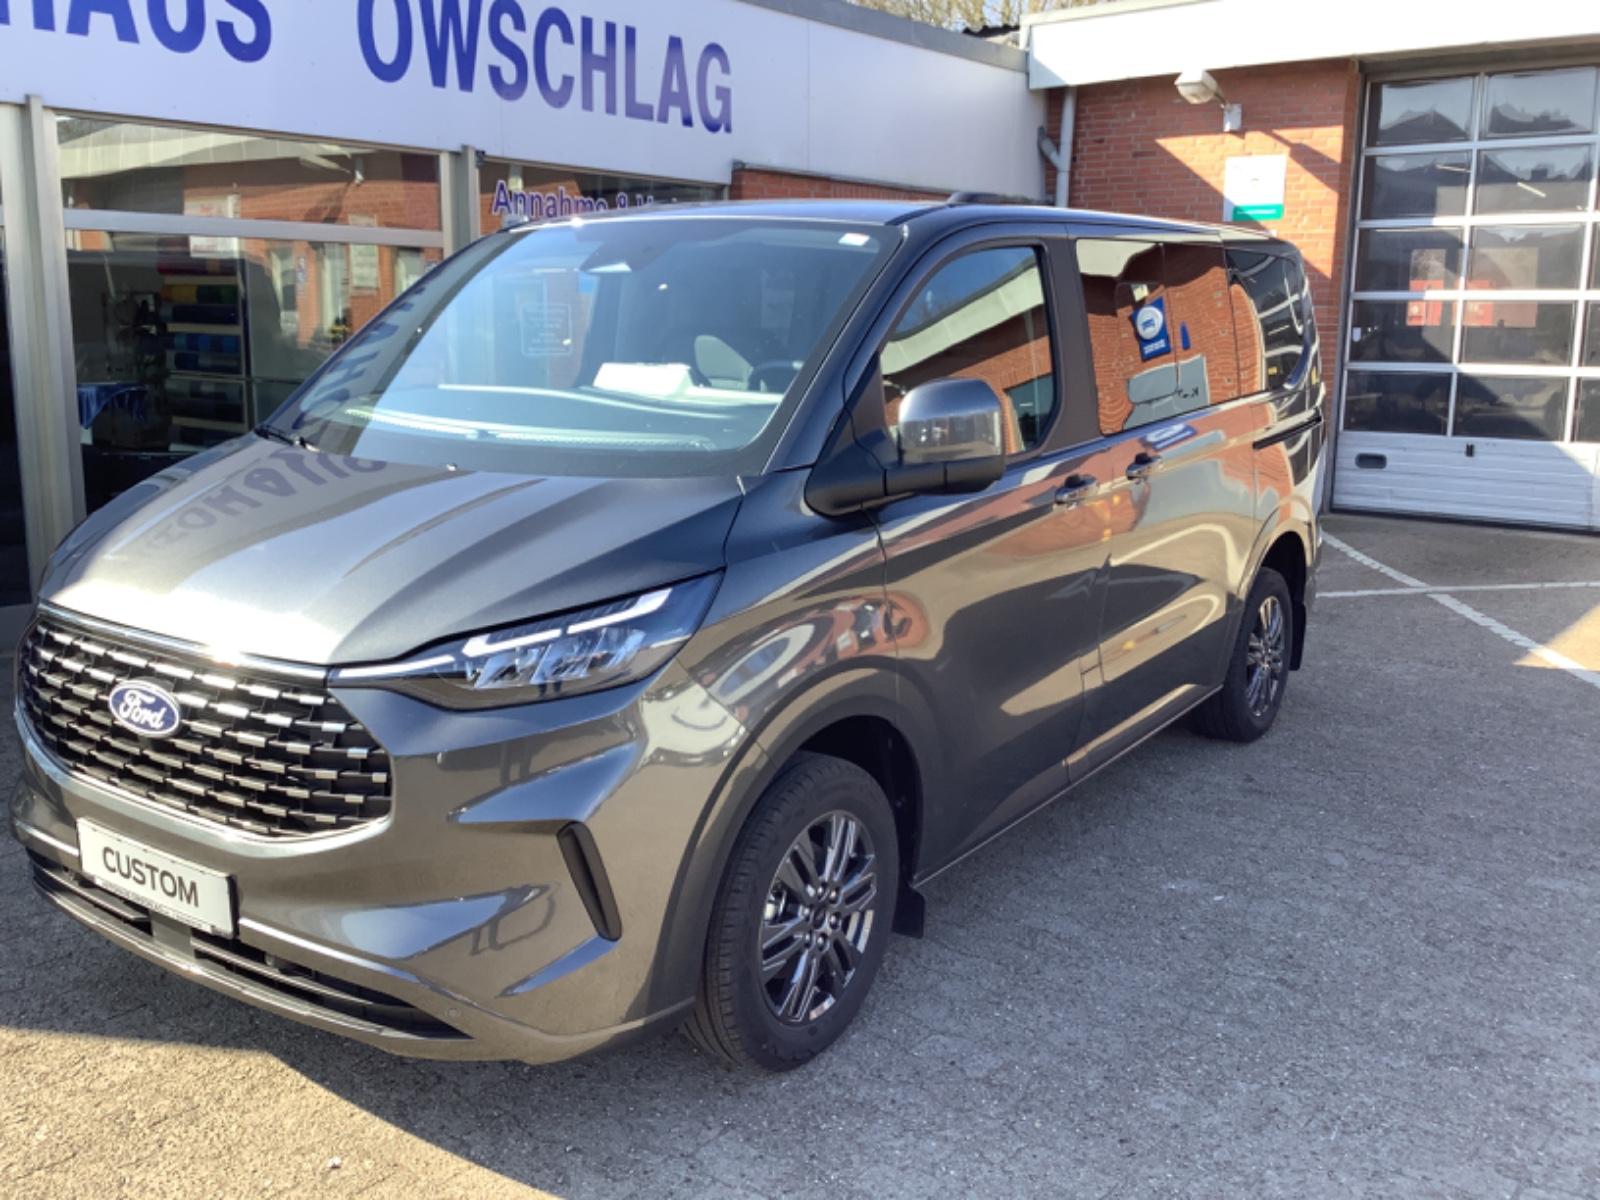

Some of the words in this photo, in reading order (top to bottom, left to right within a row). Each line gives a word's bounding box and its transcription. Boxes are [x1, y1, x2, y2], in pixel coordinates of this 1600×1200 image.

[0, 0, 272, 63] AUS
[357, 0, 732, 134] OWSCHLAG
[119, 689, 168, 729] Ford
[102, 846, 199, 907] CUSTOM
